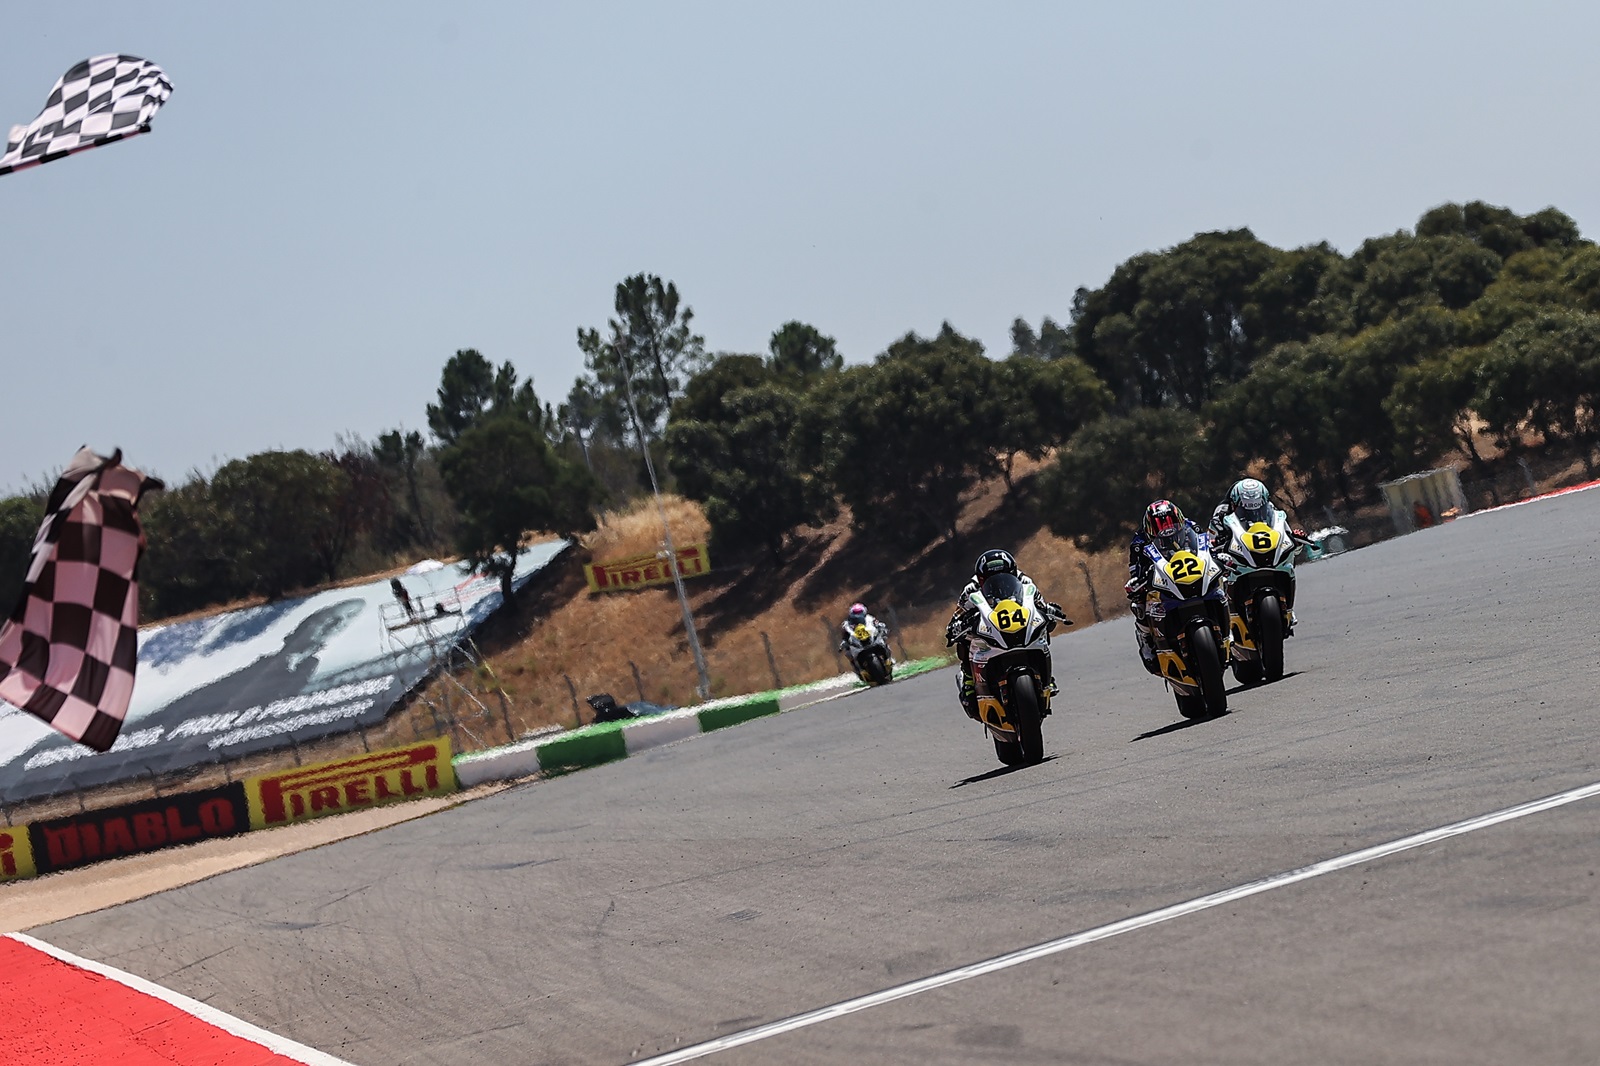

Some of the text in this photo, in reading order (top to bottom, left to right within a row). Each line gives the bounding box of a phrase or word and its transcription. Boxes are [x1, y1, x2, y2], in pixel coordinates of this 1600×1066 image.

[1252, 531, 1272, 550] 6
[592, 547, 702, 588] PIRELLI
[1170, 557, 1203, 579] 22
[996, 608, 1027, 630] 64
[259, 745, 439, 823] PIRELLI
[43, 796, 235, 865] DIABLO
